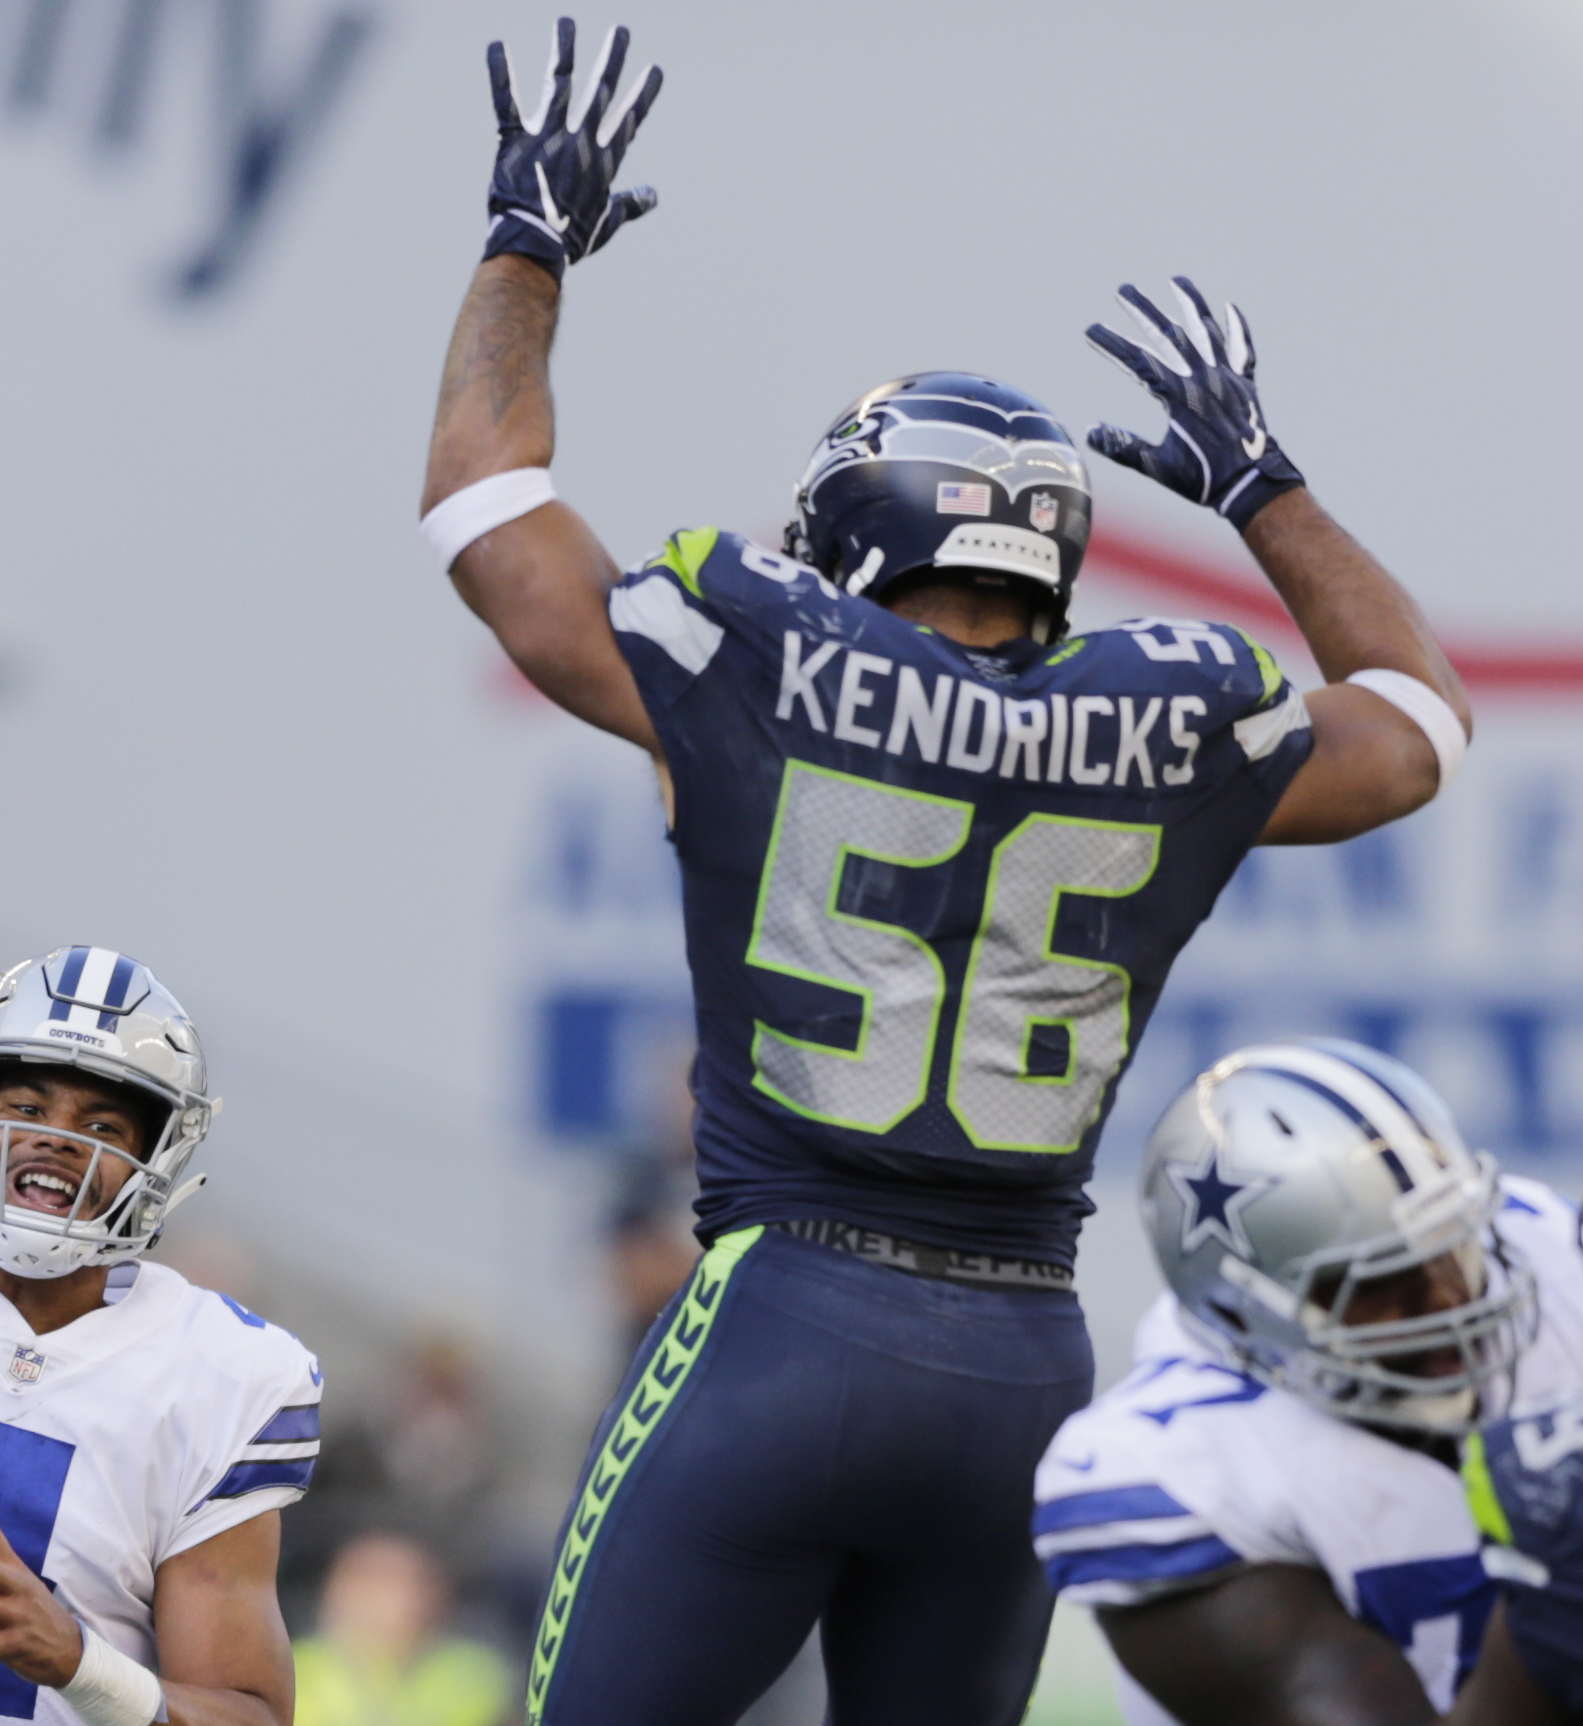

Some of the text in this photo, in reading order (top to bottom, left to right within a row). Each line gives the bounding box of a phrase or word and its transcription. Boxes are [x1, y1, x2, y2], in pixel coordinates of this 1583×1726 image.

[957, 536, 1052, 562] SEATTLE
[775, 632, 1207, 788] KENDRICKS
[745, 757, 1163, 1155] 56
[49, 1028, 106, 1048] COWBOYS
